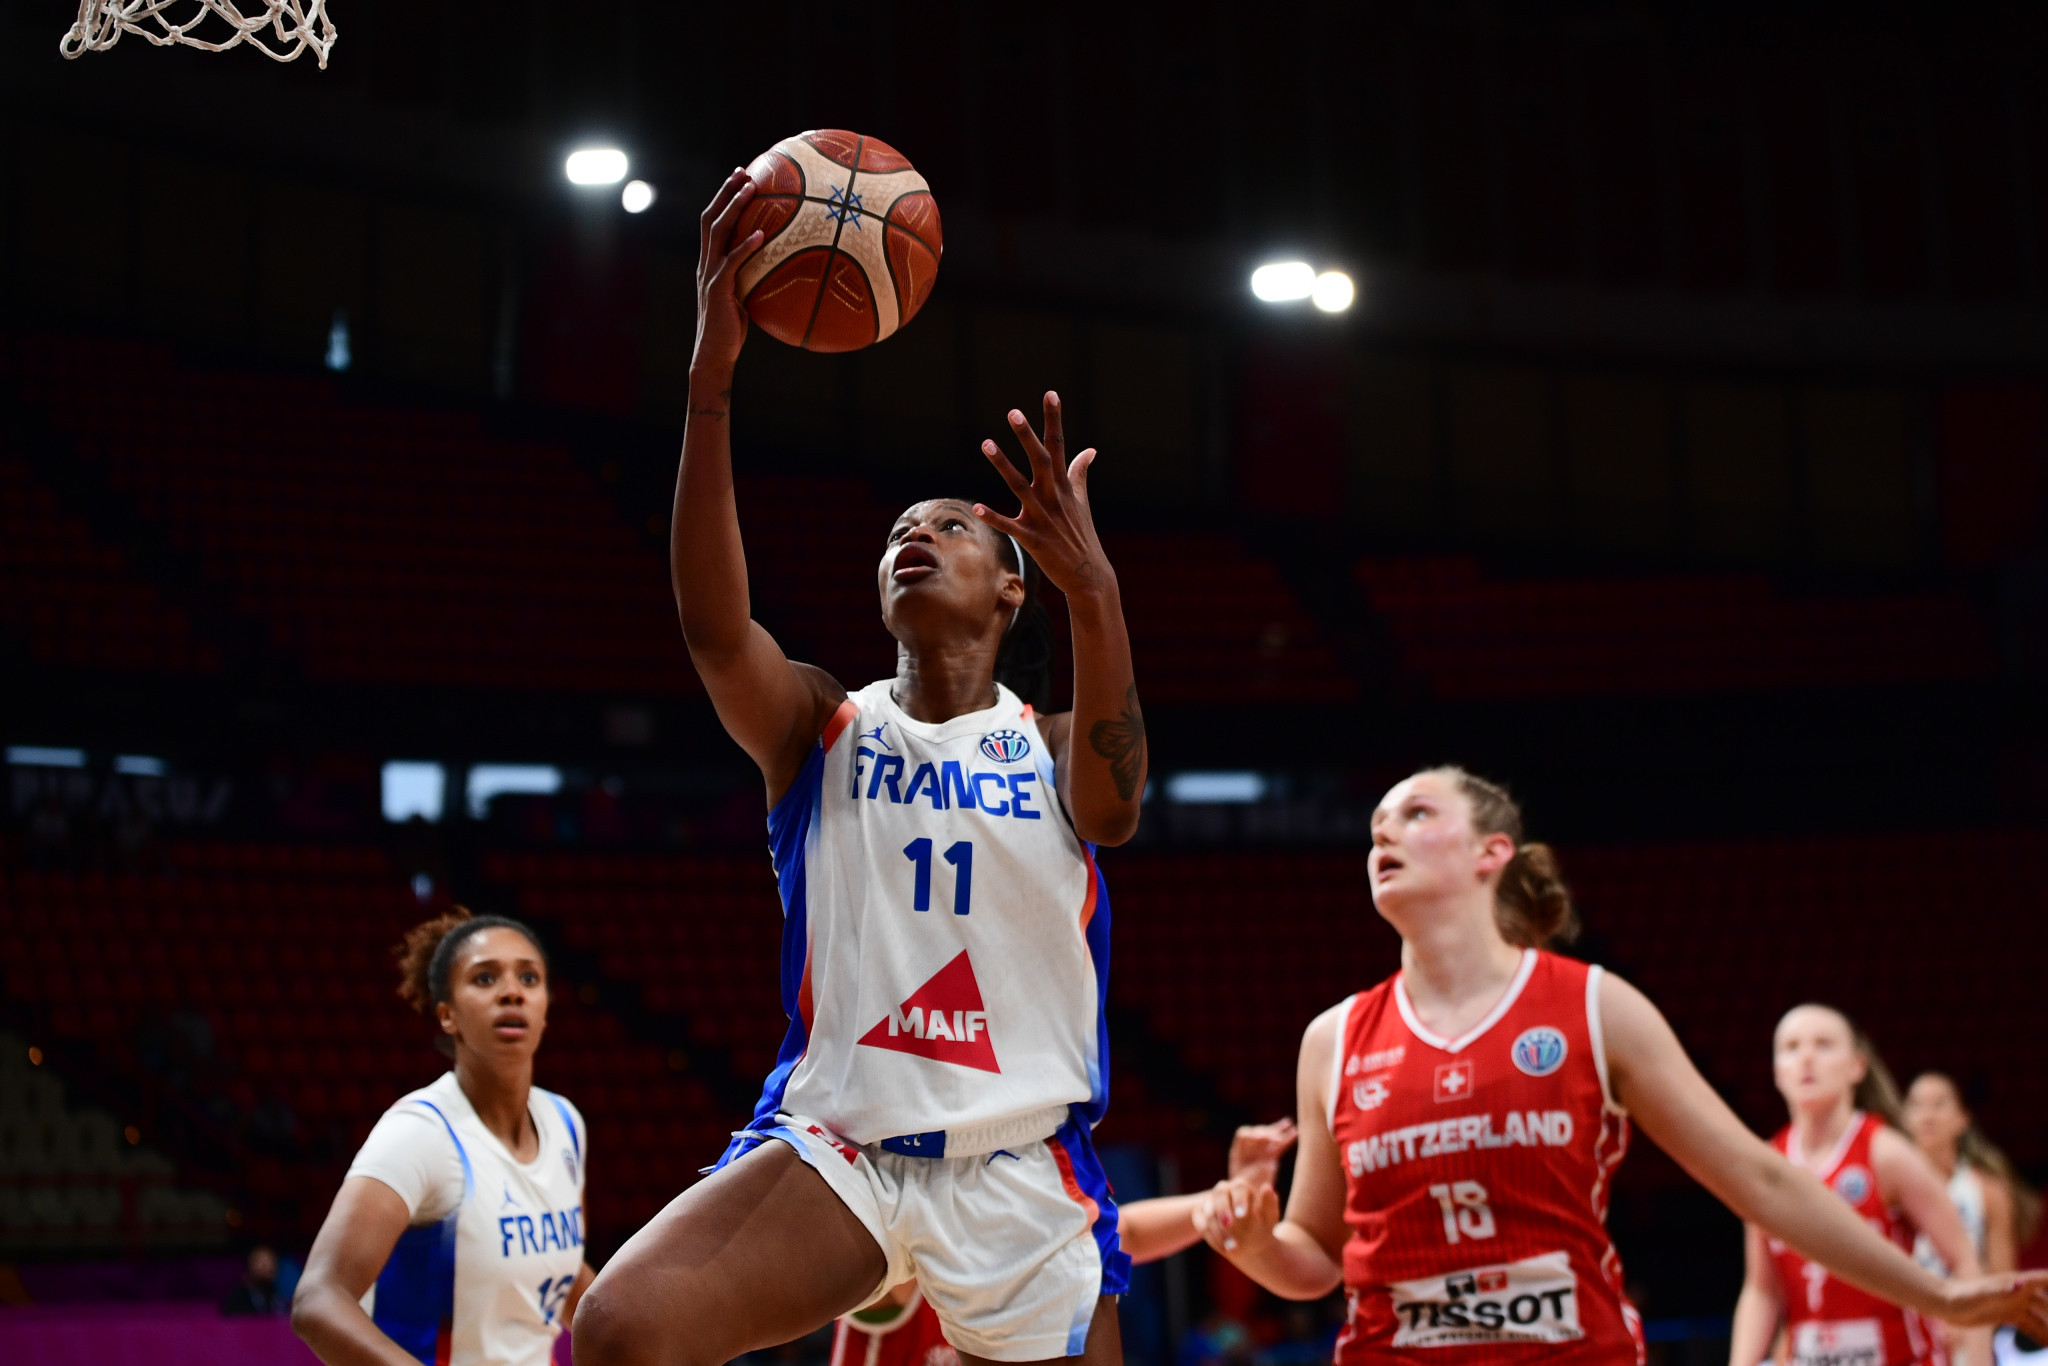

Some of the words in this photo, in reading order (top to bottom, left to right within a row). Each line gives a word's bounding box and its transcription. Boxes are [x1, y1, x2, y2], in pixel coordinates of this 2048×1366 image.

[852, 746, 1041, 819] FRANCE
[903, 838, 973, 915] 11
[887, 1006, 988, 1042] MAIF
[1348, 1110, 1573, 1177] SWITZERLAND
[1398, 1288, 1572, 1331] TISSOT
